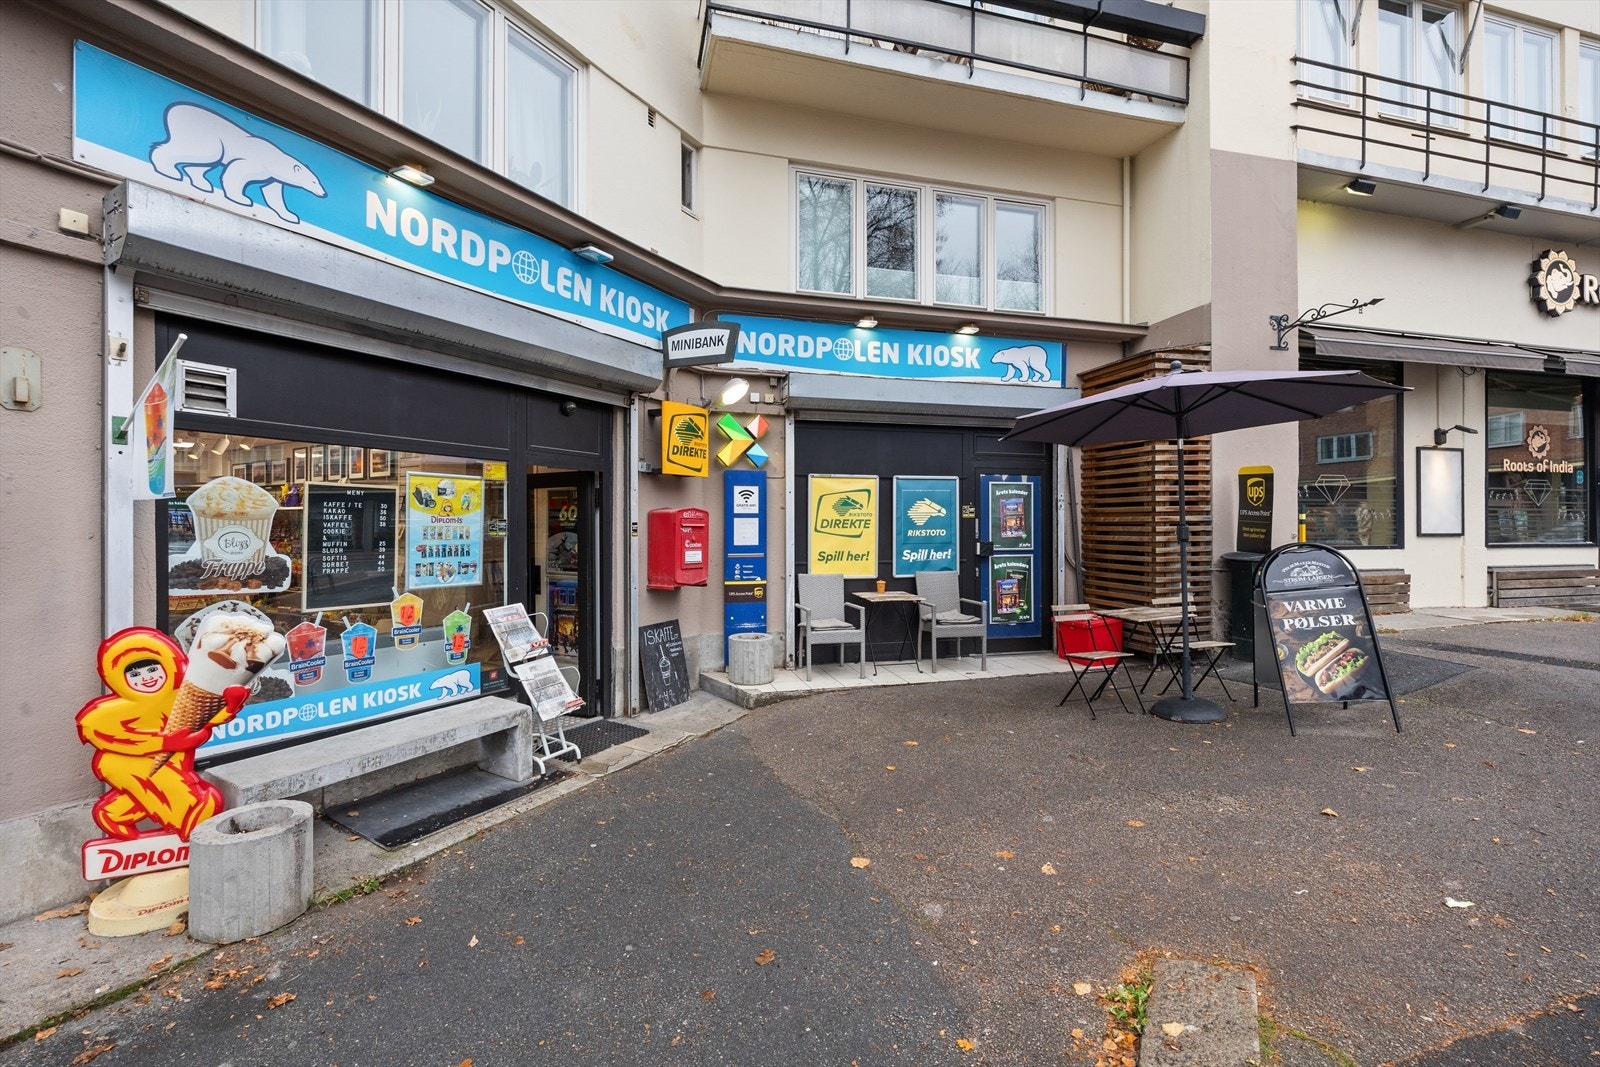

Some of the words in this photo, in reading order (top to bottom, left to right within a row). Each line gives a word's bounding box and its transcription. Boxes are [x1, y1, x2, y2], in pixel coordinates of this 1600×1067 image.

[600, 283, 670, 333] KIOSK
[670, 333, 725, 353] MINIBANK
[907, 343, 981, 369] KIOSK
[672, 445, 707, 459] DIREKTE
[1503, 458, 1534, 472] Roots
[1536, 459, 1549, 473] of
[1550, 460, 1574, 473] India
[1248, 486, 1264, 502] ups
[820, 518, 871, 529] DIREKTE
[907, 529, 947, 537] RIKSTOTO
[817, 550, 844, 564] Spill
[846, 550, 871, 561] her!
[902, 549, 929, 563] Spill
[930, 548, 952, 560] her!
[1282, 597, 1347, 613] VARME
[1282, 614, 1356, 630] PØLSER
[393, 626, 420, 635] BrainCooler
[643, 626, 674, 647] ISKAFFE
[290, 658, 325, 670] BrainCooler
[344, 659, 375, 669] BrainCooler
[363, 682, 422, 710] KIOSK
